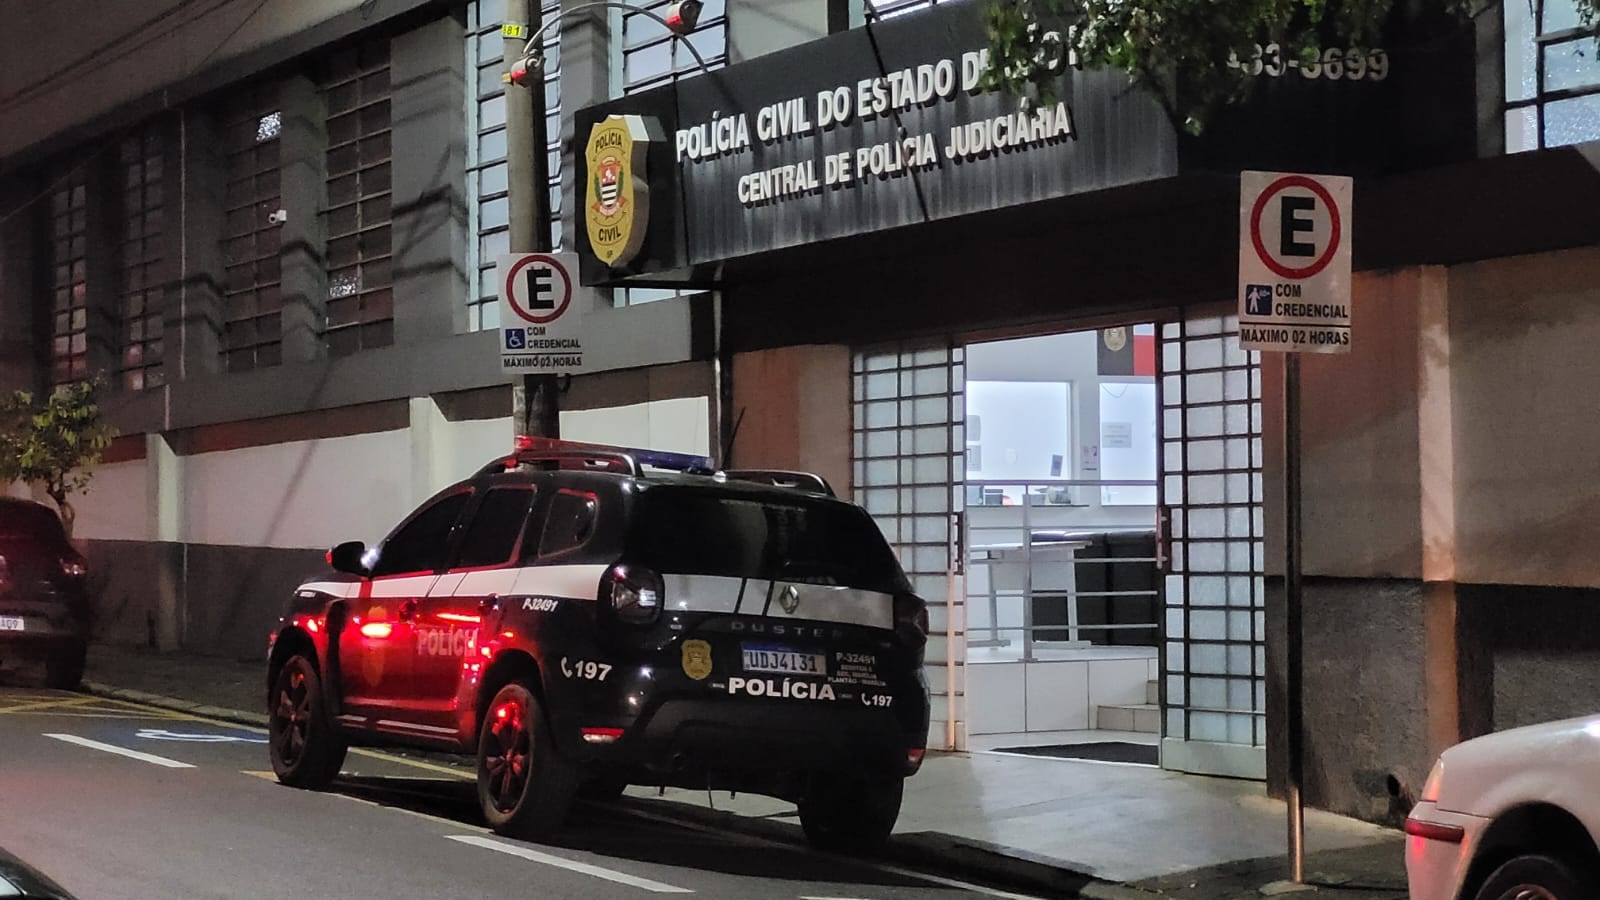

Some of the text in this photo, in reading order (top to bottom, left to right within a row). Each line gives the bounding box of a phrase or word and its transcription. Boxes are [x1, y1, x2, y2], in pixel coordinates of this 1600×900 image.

[676, 110, 750, 162] POLÍCIA
[757, 97, 811, 142] CIVIL
[818, 86, 851, 127] DO
[857, 59, 954, 117] ESTADO
[595, 129, 622, 153] POLÍCIA
[738, 97, 1071, 204] CENTRAL DE POLÍCIA JUDICIÁRIA
[598, 225, 621, 242] CIVIL
[1280, 196, 1316, 257] E
[526, 267, 555, 309] E
[1275, 284, 1302, 298] COM
[1275, 303, 1348, 319] CREDENCIAL
[527, 327, 546, 336] COM
[1292, 330, 1306, 344] 02
[1309, 331, 1349, 345] HORAS
[527, 339, 581, 349] CREDENCIAL
[540, 358, 551, 368] 02
[552, 357, 582, 367] HORAS
[417, 624, 479, 657] POLÍCIA
[574, 661, 612, 681] 197
[750, 651, 817, 672] UDJ4131
[728, 678, 836, 700] POLÍCIA
[871, 695, 893, 707] 197
